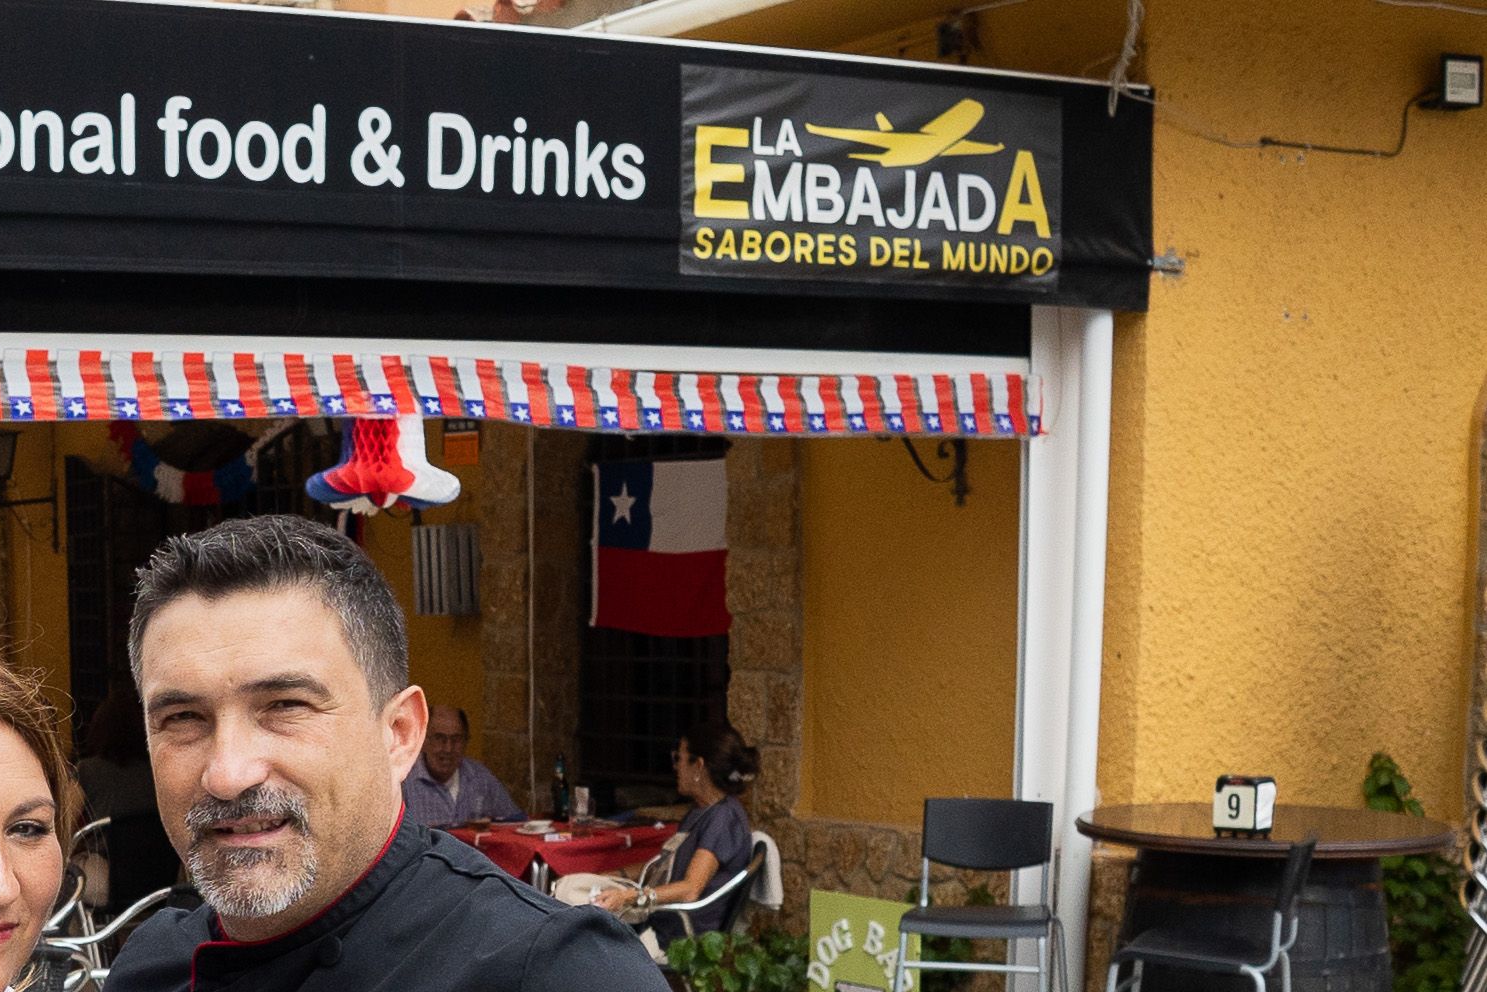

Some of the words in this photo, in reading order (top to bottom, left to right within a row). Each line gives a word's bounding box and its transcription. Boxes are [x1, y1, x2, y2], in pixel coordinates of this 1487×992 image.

[156, 96, 327, 185] food
[350, 106, 406, 188] &
[427, 111, 646, 201] Drinks
[752, 116, 803, 157] LA
[693, 124, 1052, 239] EMBAJADA
[692, 226, 858, 266] SABORES
[869, 236, 930, 270] DEL
[942, 240, 1054, 276] MUNDO
[1227, 793, 1241, 820] 9
[806, 917, 854, 990] DOG
